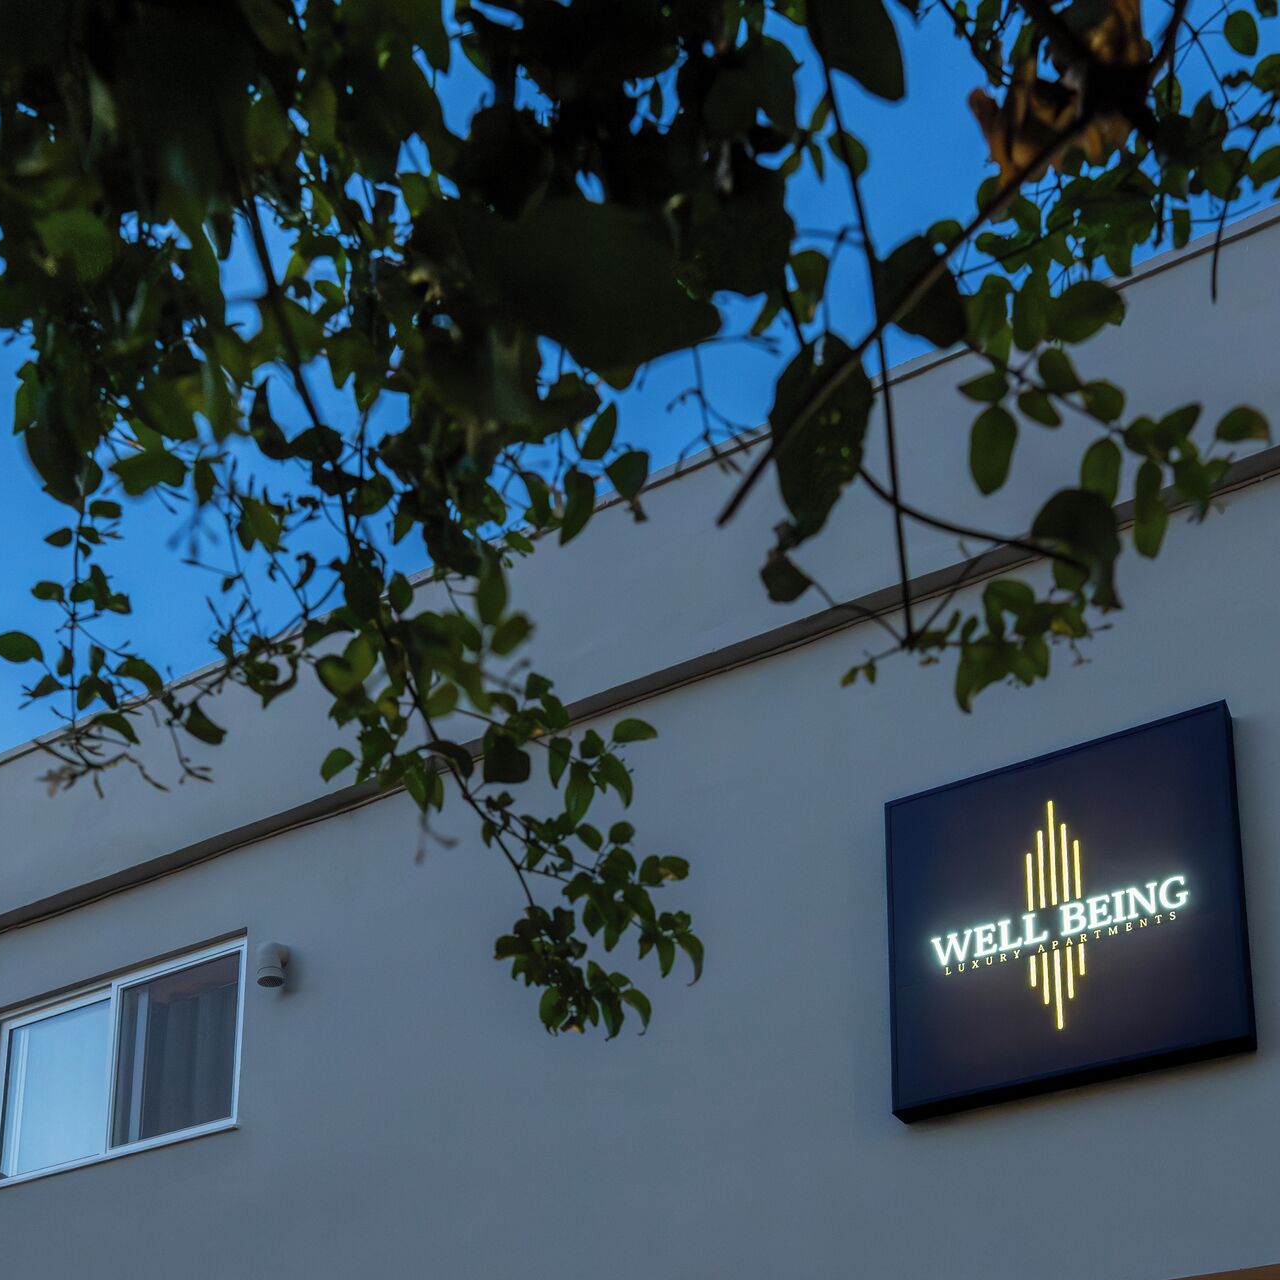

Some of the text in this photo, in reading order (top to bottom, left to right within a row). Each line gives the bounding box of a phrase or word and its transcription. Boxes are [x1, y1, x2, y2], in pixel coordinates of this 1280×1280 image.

[931, 876, 1189, 965] WELL BEING
[945, 911, 1177, 976] LUXURY APARTMENTS
